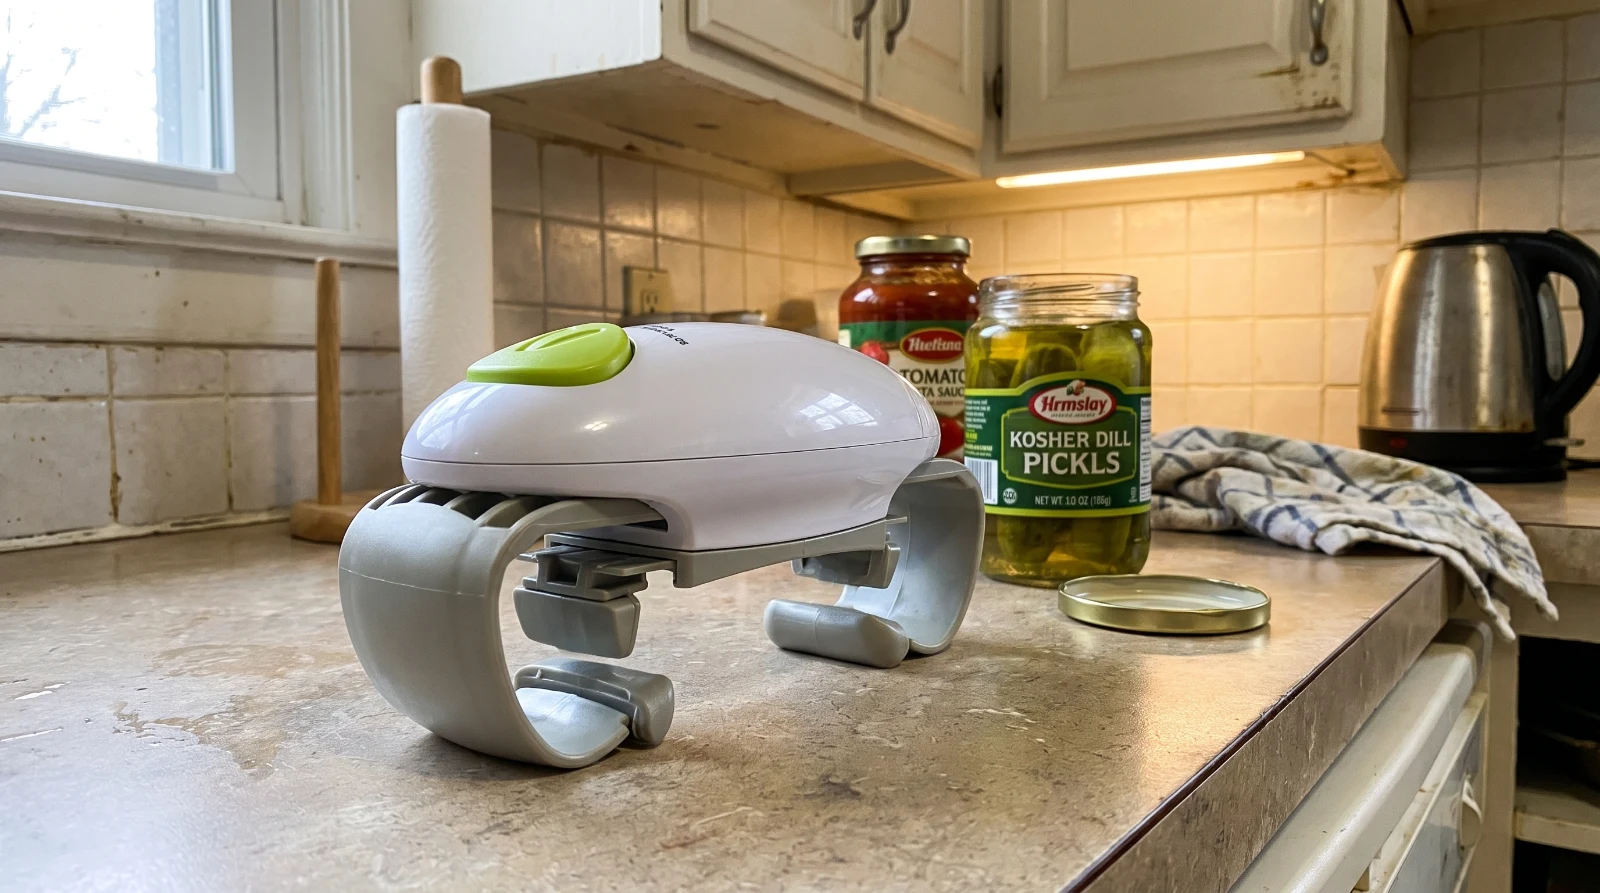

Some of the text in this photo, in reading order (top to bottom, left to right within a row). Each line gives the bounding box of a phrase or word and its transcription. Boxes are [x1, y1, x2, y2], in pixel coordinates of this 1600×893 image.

[937, 386, 965, 397] SAUC
[1041, 395, 1108, 415] Hrmslay
[1010, 431, 1132, 448] KOSHER DILL
[1023, 452, 1120, 475] PICKLS
[1035, 495, 1049, 505] NET
[1078, 495, 1089, 505] OZ
